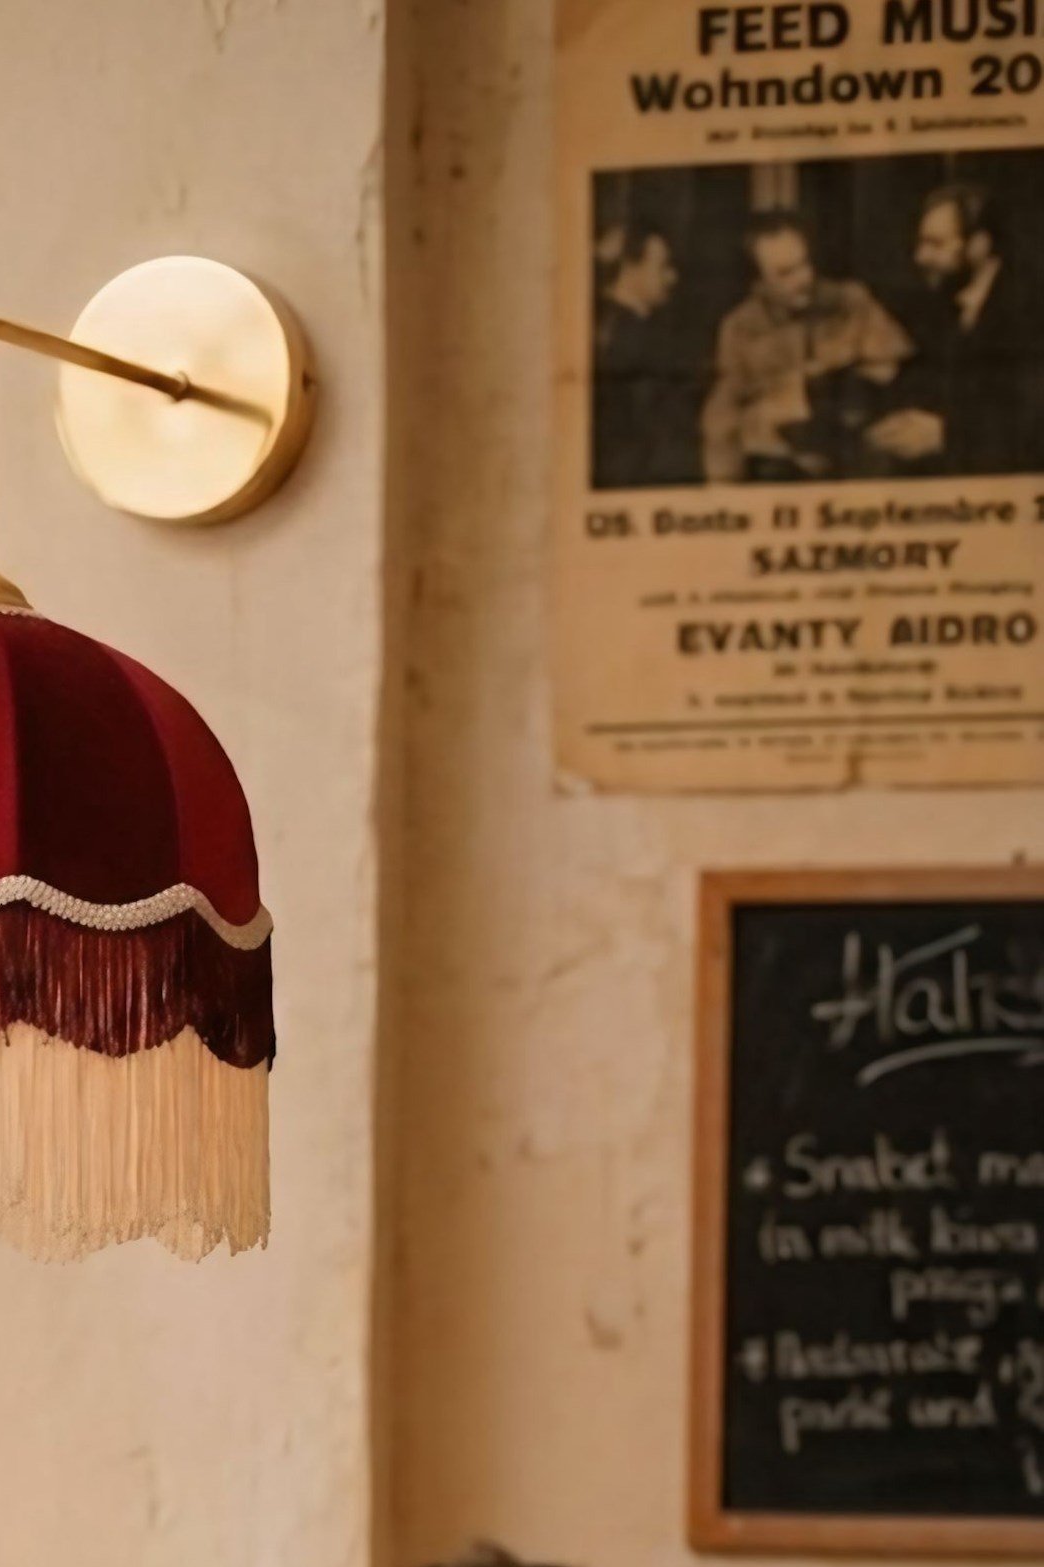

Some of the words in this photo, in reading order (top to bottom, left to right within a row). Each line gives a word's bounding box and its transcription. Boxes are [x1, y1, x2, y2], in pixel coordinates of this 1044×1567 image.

[698, 2, 850, 56] FEED
[882, 0, 1044, 45] MUSI
[630, 63, 944, 114] Wohndown
[970, 53, 1044, 97] 20
[676, 617, 863, 655] EVANTY
